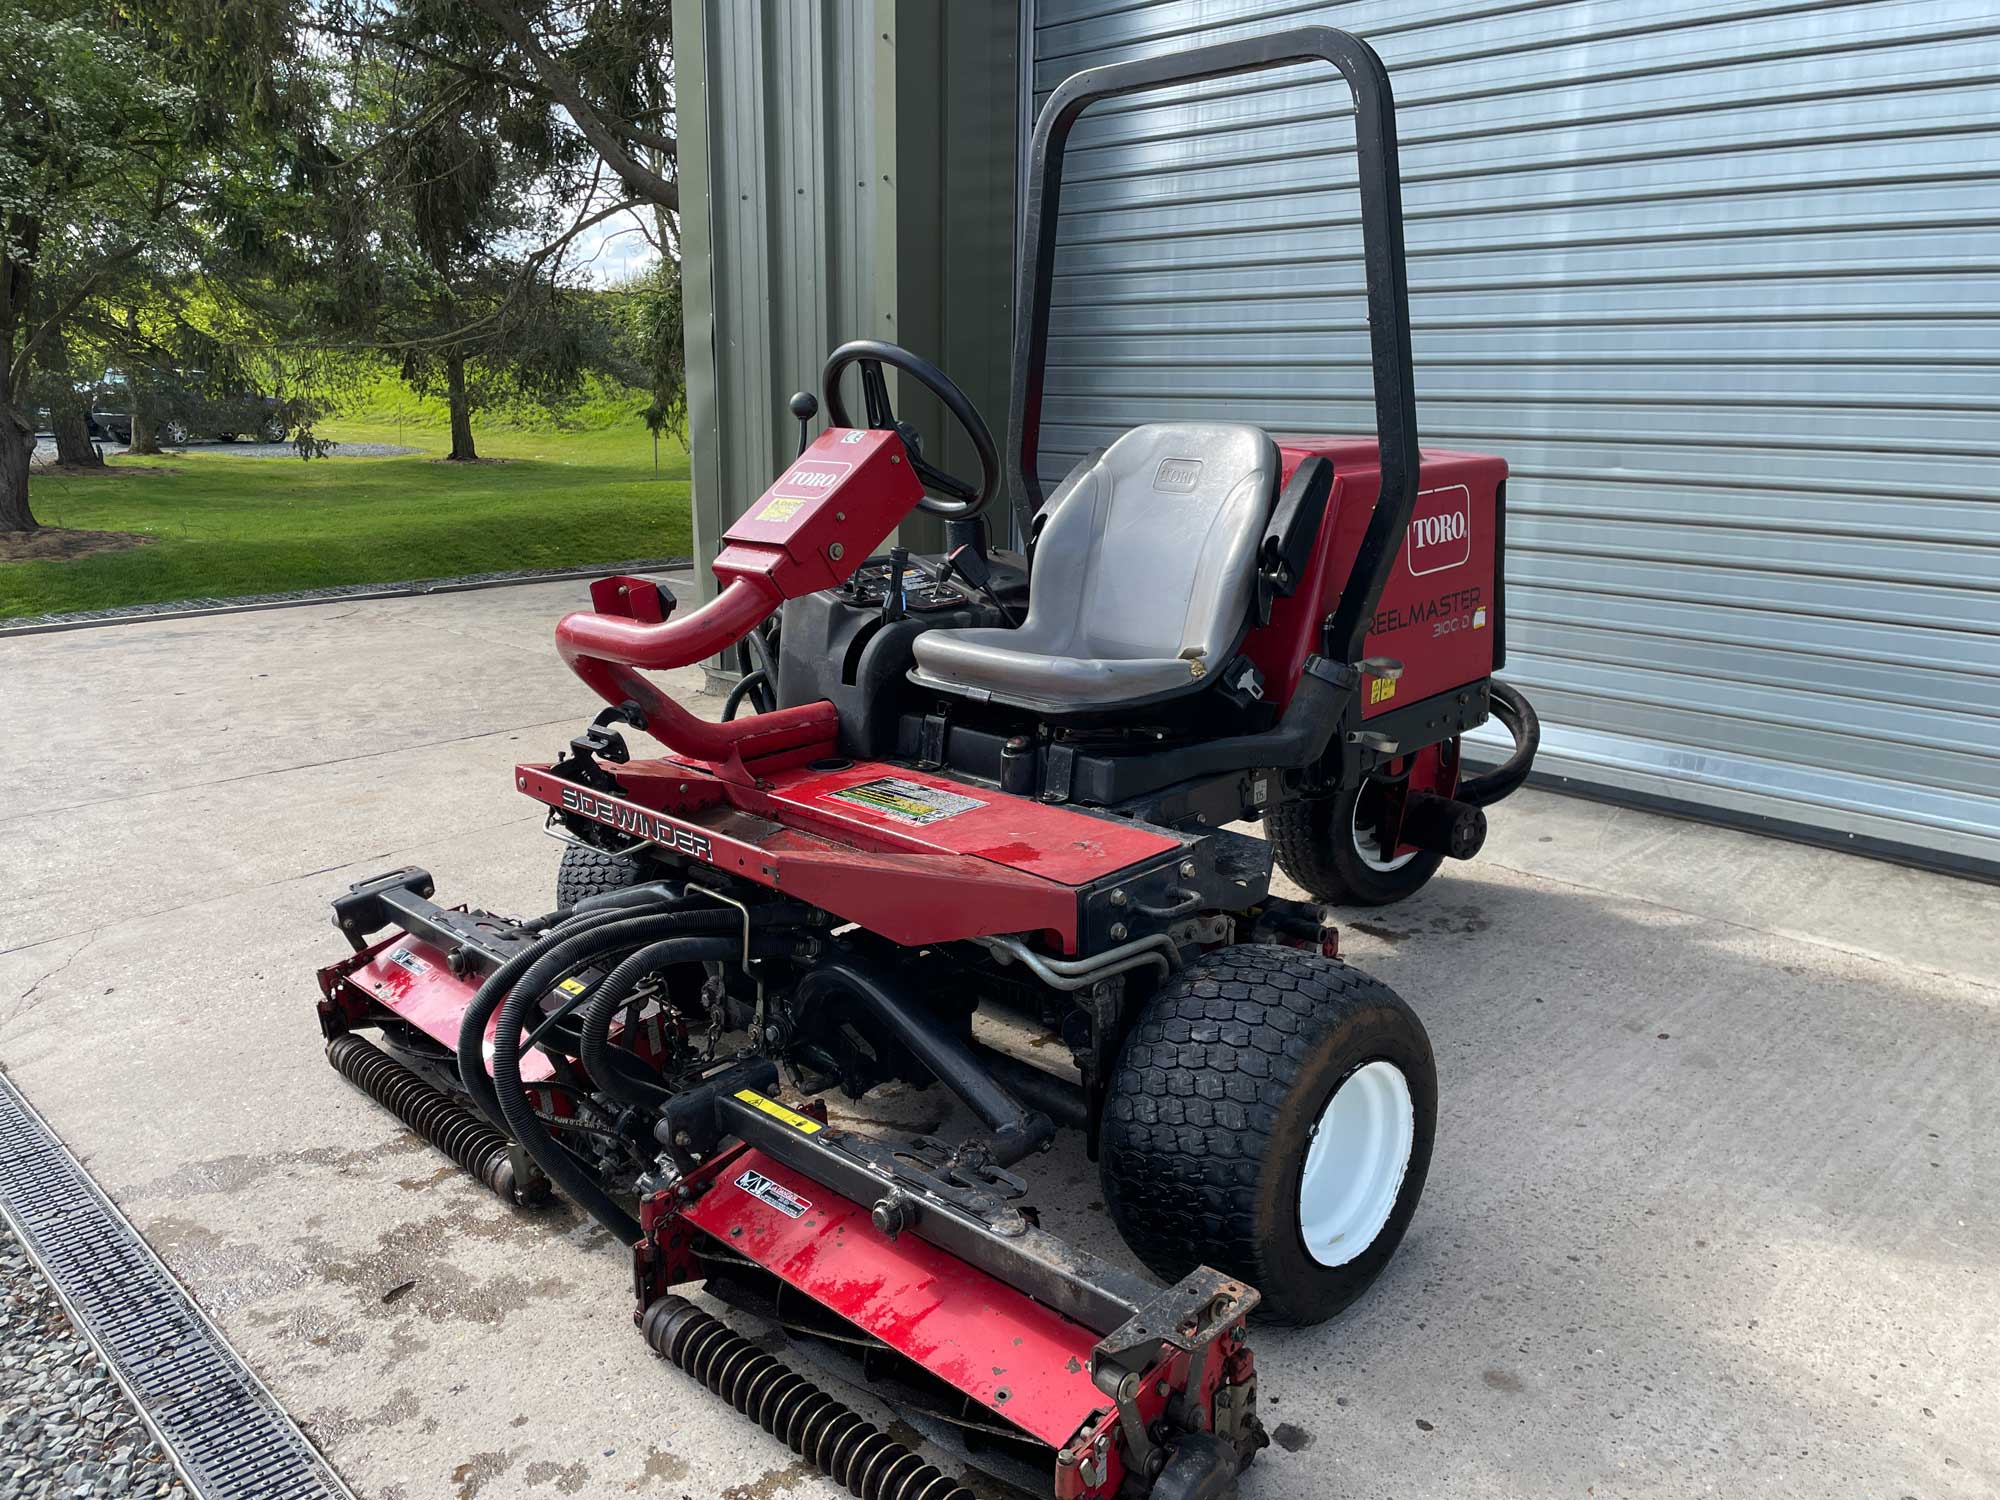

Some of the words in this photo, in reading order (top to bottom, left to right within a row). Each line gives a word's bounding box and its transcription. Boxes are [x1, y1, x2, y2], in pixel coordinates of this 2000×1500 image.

[788, 471, 836, 487] TORO
[1413, 511, 1465, 548] TORO
[1368, 587, 1480, 636] REELMASTER
[562, 787, 713, 862] SIDEWINDER
